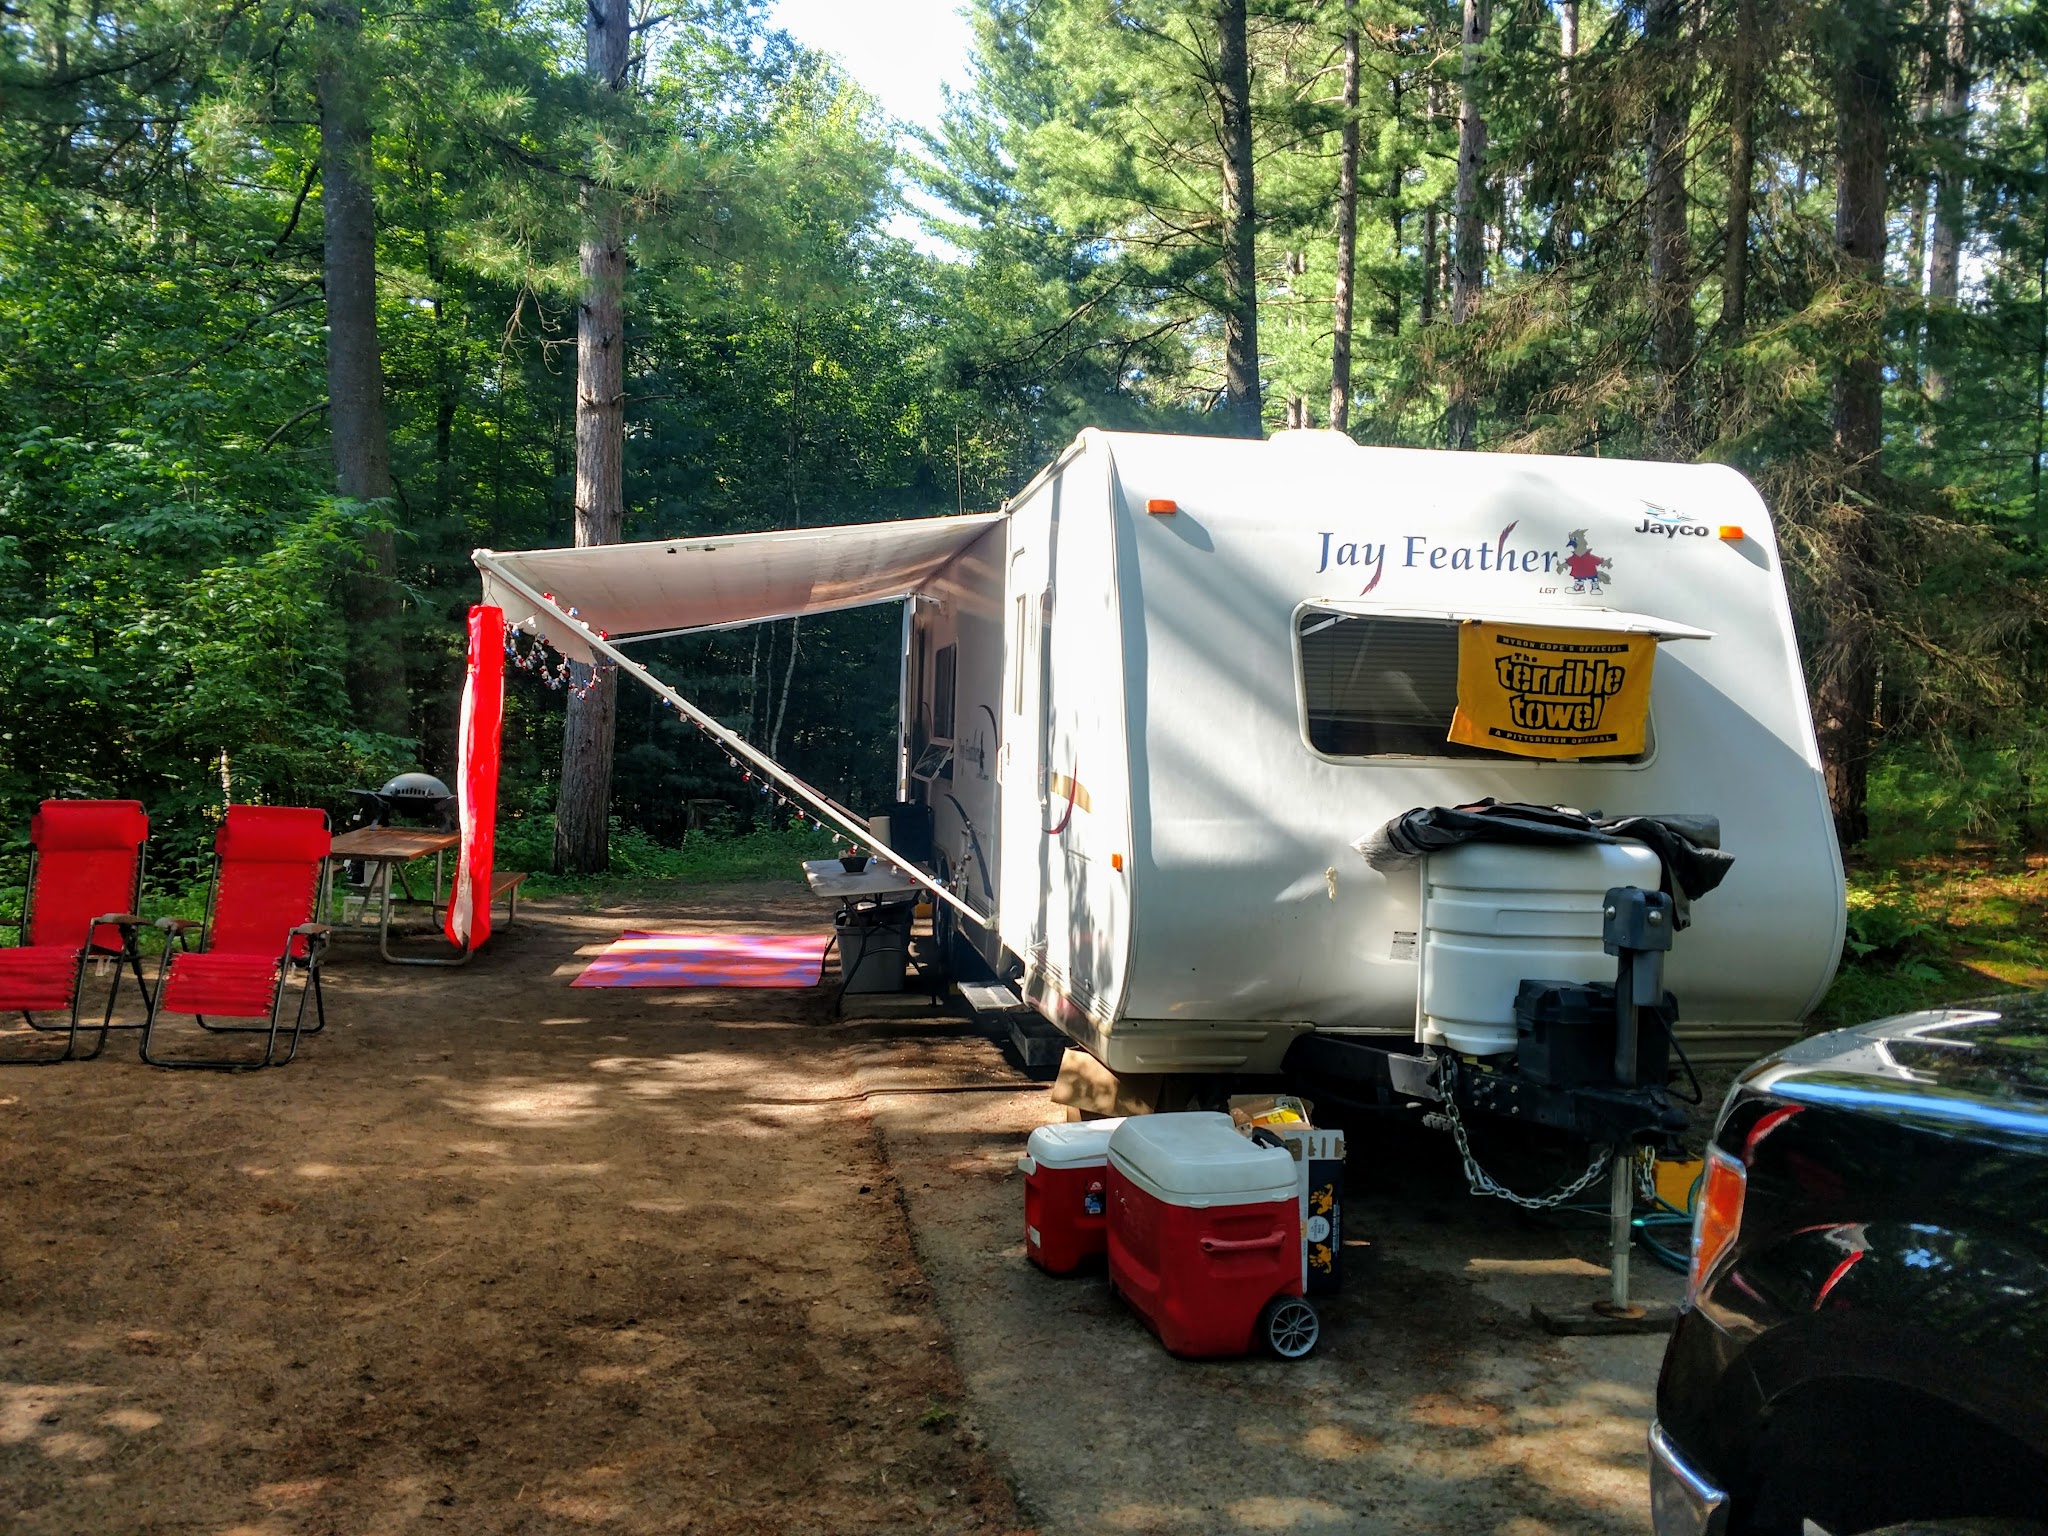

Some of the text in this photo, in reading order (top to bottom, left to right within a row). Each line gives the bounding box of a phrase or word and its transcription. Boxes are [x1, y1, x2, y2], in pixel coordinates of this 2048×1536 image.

[1634, 518, 1710, 539] Jayco
[1316, 519, 1557, 597] Jay Feather
[1502, 636, 1623, 653] MYRON COPE'S OFFICIAL
[1514, 652, 1539, 663] The
[1495, 655, 1626, 696] terrible
[1509, 693, 1606, 731] towel
[1494, 729, 1502, 738] A
[1506, 732, 1567, 744] PITTSBURGH
